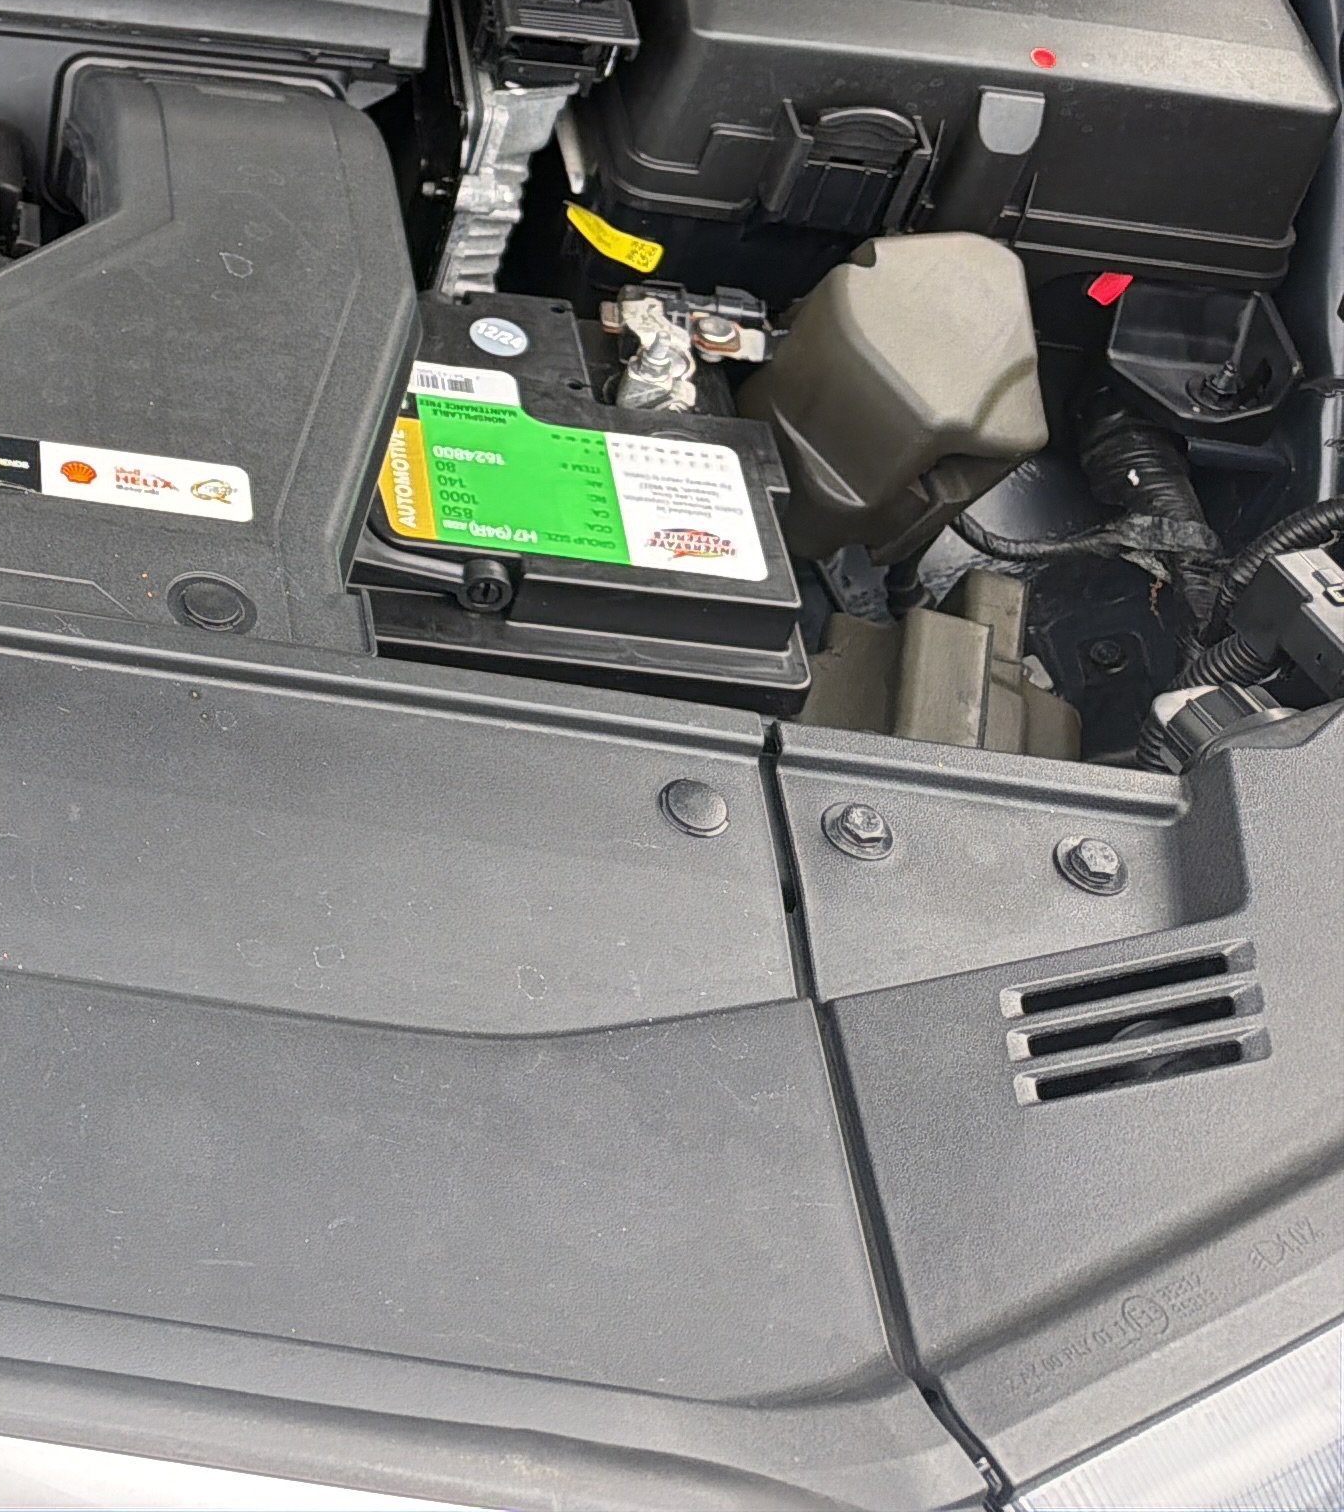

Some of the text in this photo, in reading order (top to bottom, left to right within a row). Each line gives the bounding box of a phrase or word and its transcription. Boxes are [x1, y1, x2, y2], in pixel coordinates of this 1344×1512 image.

[476, 321, 523, 350] 12/24
[432, 408, 507, 425] NONSPILLABLE
[443, 401, 519, 418] MAINTENANCE
[432, 444, 506, 466] 1624800
[434, 460, 457, 474] 80
[115, 474, 175, 490] HELIX
[390, 428, 417, 529] AUTOMOTIVE
[437, 474, 468, 489] 140
[439, 489, 480, 506] 1000
[441, 504, 474, 520] 850
[574, 536, 617, 551] GROUP
[648, 539, 737, 557] INTERSTATE
[654, 531, 732, 548] BATTERIES
